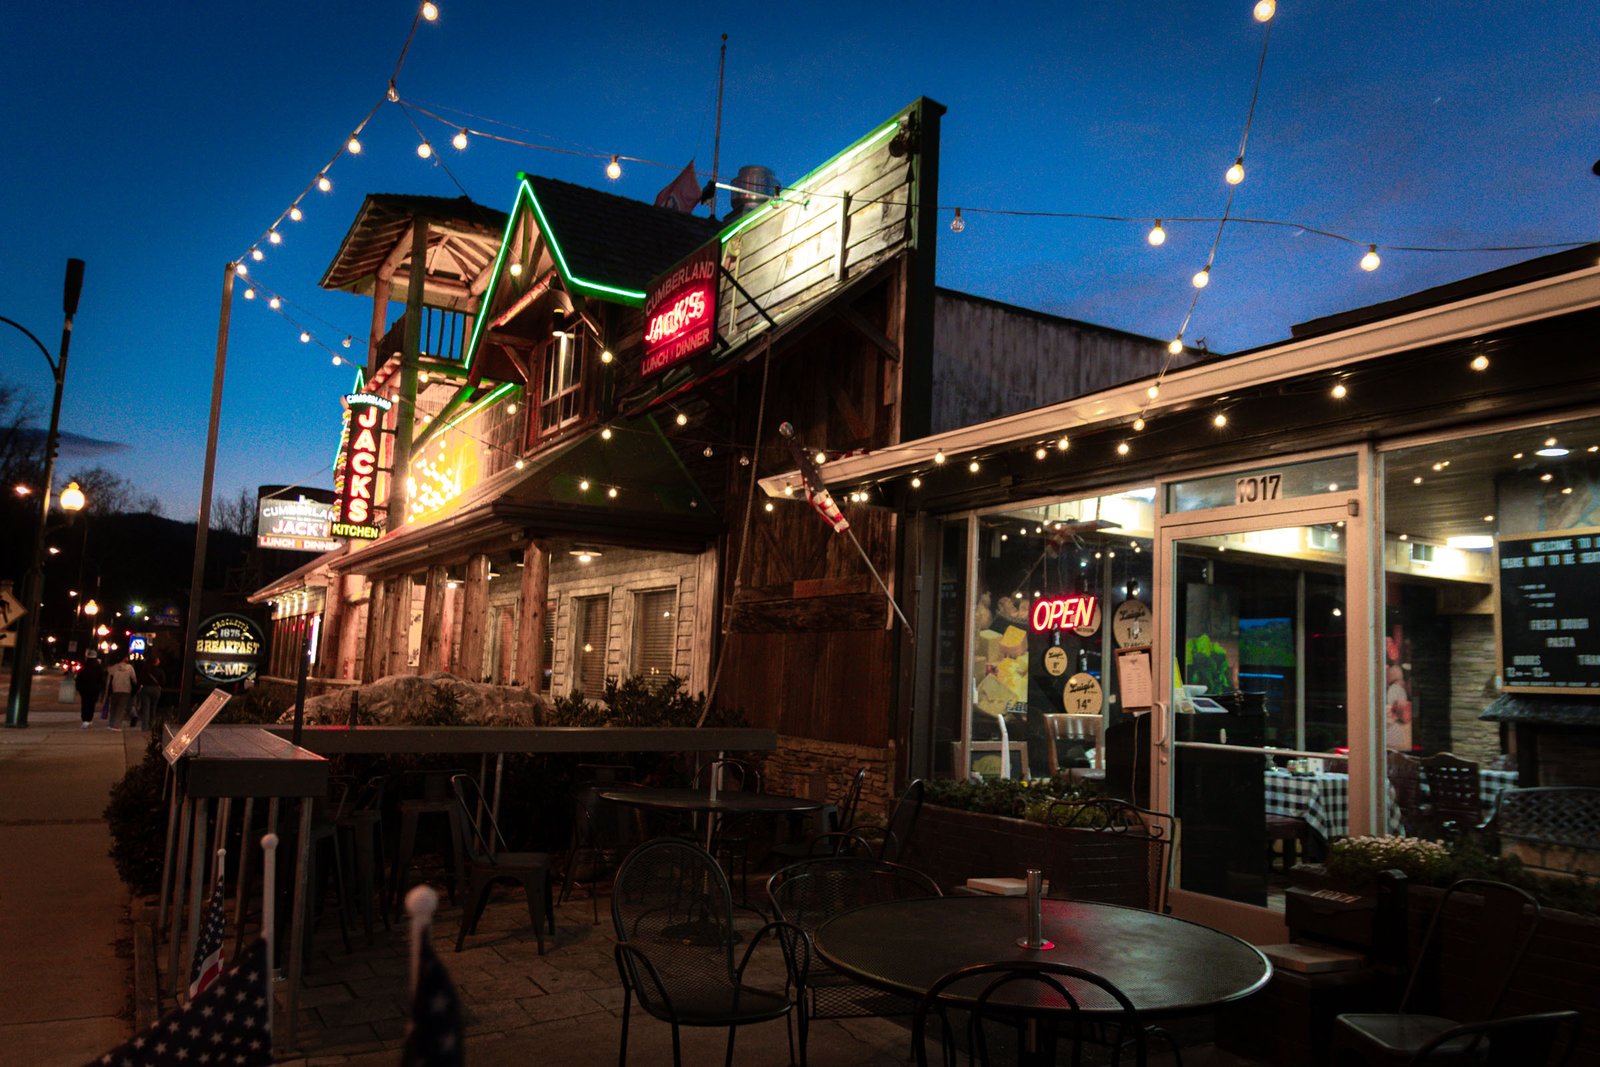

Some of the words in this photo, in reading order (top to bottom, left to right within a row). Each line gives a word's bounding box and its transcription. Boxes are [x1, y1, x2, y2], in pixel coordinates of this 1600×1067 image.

[645, 260, 715, 317] CUMBERLAND
[645, 291, 705, 344] JACK'S
[642, 350, 669, 376] LUNCH
[675, 328, 710, 359] DINNER
[348, 406, 378, 524] JACKS
[1237, 474, 1281, 503] 1017
[262, 505, 337, 521] CUMBERLAN
[332, 523, 379, 539] KITCHEN
[260, 537, 295, 548] LUNCH
[1033, 596, 1095, 632] OPEN
[195, 640, 260, 655] BREAKFAST
[1546, 636, 1576, 648] PASTA
[1077, 698, 1091, 710] 14"
